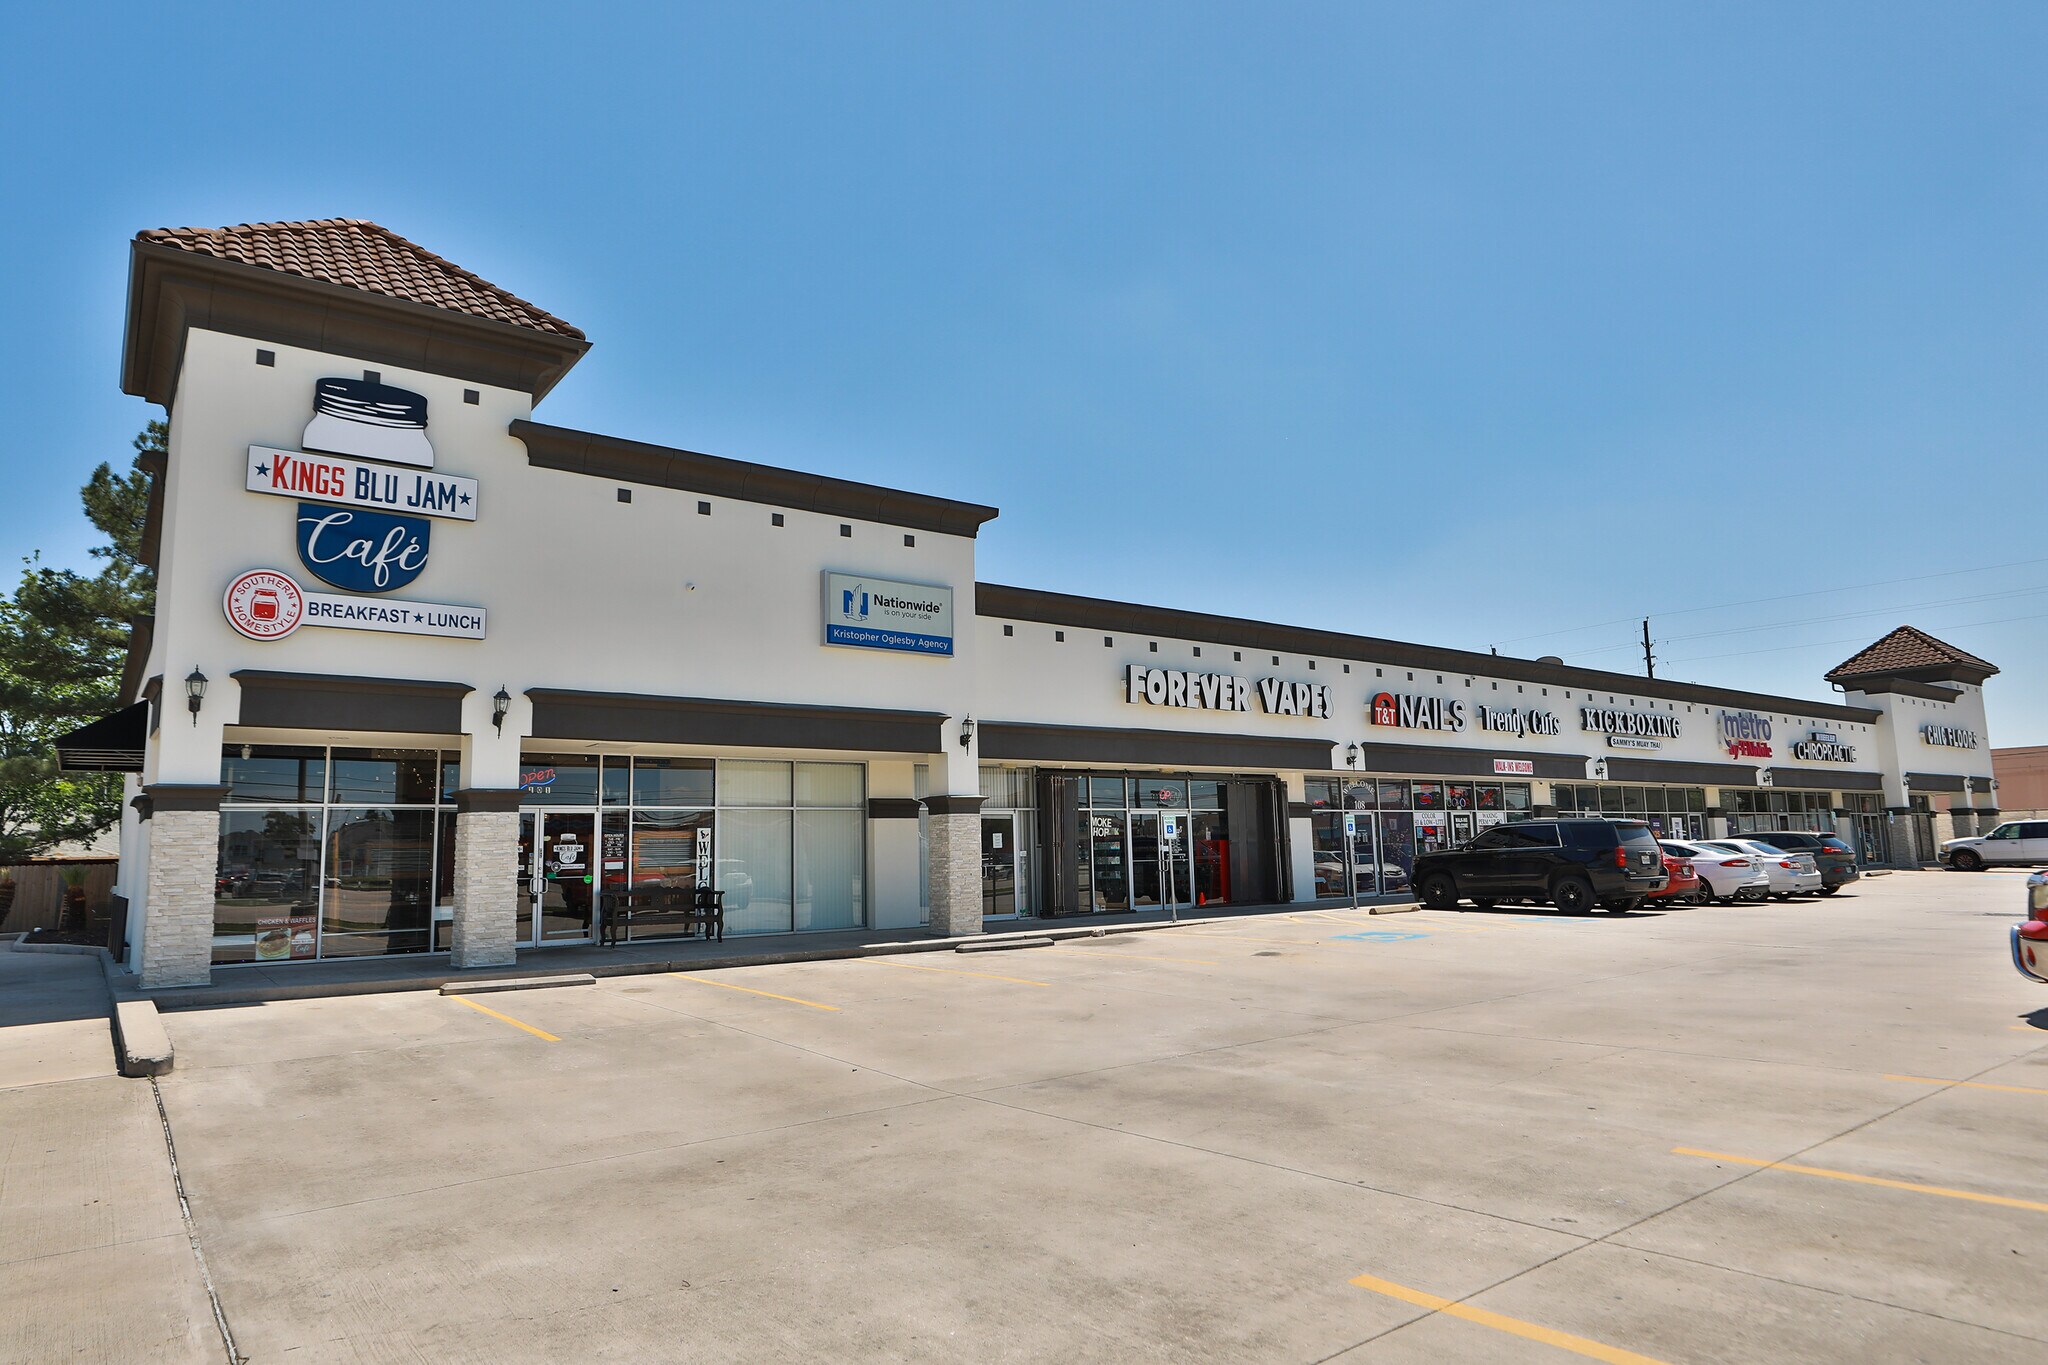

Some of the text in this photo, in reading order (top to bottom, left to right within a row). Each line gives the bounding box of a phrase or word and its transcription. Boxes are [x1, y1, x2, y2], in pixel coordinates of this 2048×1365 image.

[272, 454, 457, 513] KINGS BLU JAM
[298, 512, 428, 587] Café
[236, 576, 296, 600] SOUTHERN
[873, 594, 941, 613] Nationwide
[234, 605, 296, 633] HOMESTYLE
[308, 602, 481, 630] BREAKFAST LUNCH
[902, 611, 917, 620] your
[918, 613, 932, 621] side
[833, 629, 949, 651] Kristopher Oglesby Agency
[1127, 664, 1335, 719] FOREVER VAPES
[1375, 707, 1396, 725] T&T
[1397, 694, 1468, 733] NAILS
[1480, 705, 1561, 738] Trendy Cuts
[1582, 708, 1682, 738] KICKBOXING
[1724, 712, 1772, 741] metro
[1926, 725, 1977, 749] CHIC FLOORS
[1612, 738, 1636, 747] SAMMY'S
[1636, 740, 1649, 748] MUAY
[1796, 742, 1857, 763] CHIROPRACTIC
[1343, 780, 1376, 796] WELCOME
[1091, 816, 1112, 828] MOKE
[1093, 827, 1110, 837] HOP
[290, 916, 316, 924] WAFFLES
